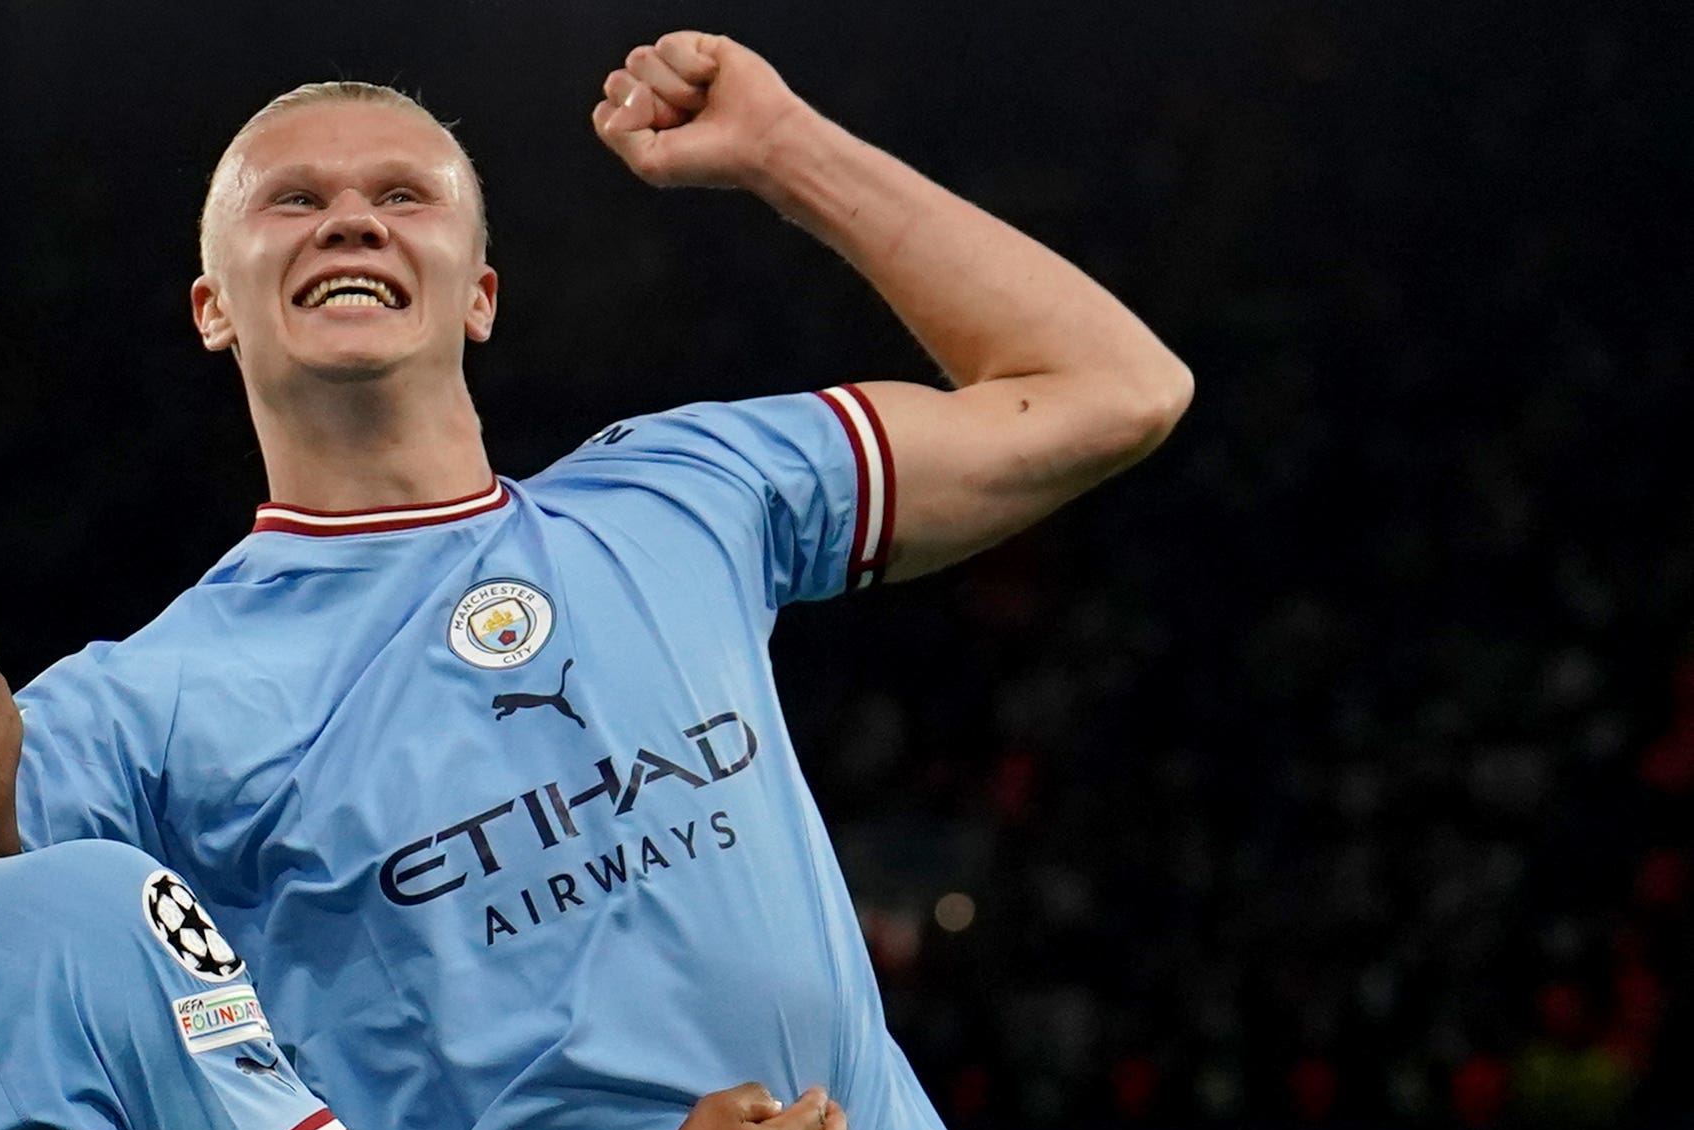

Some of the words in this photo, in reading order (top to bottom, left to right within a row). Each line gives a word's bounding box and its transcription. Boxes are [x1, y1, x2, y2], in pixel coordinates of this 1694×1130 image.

[454, 585, 536, 631] MANCHESTER
[502, 645, 533, 664] CITY
[378, 711, 758, 906] ETIHAD
[485, 811, 737, 946] AIRWAYS
[178, 999, 205, 1014] UEFA
[181, 1001, 264, 1035] FOUNDAT
